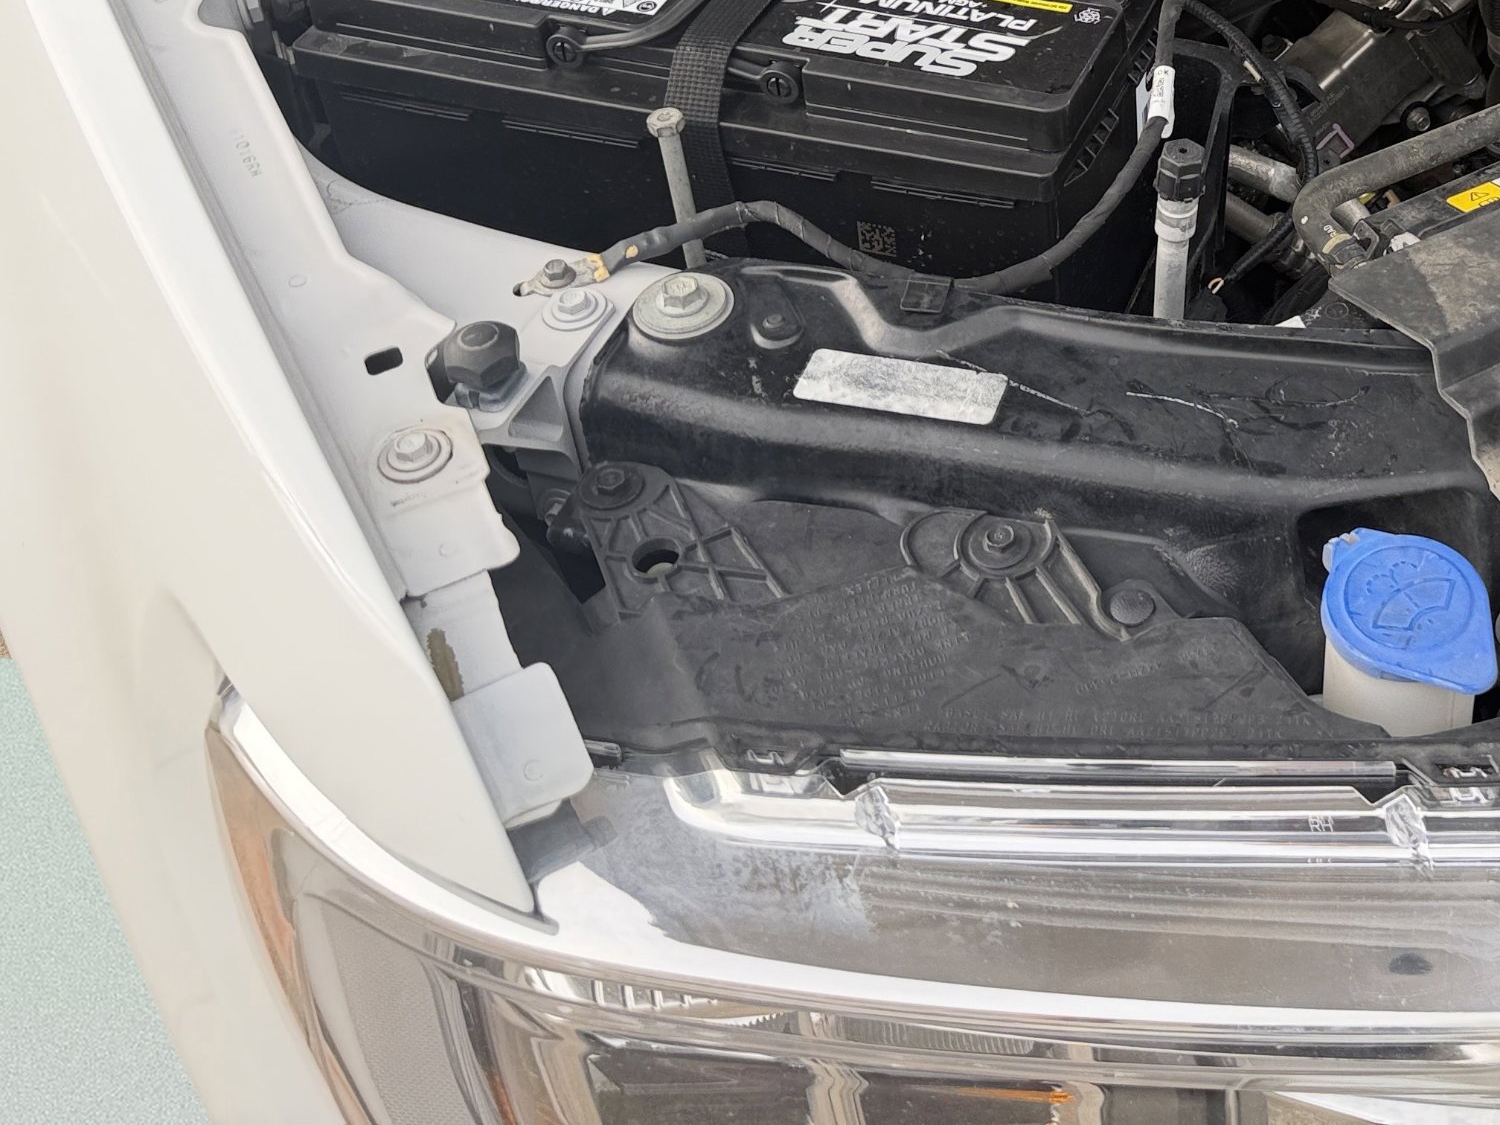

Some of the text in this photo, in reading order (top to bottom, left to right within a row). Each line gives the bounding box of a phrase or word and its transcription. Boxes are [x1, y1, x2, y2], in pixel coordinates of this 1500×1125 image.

[782, 25, 977, 77] SUPER
[794, 7, 1030, 63] START
[1307, 815, 1335, 833] RH
